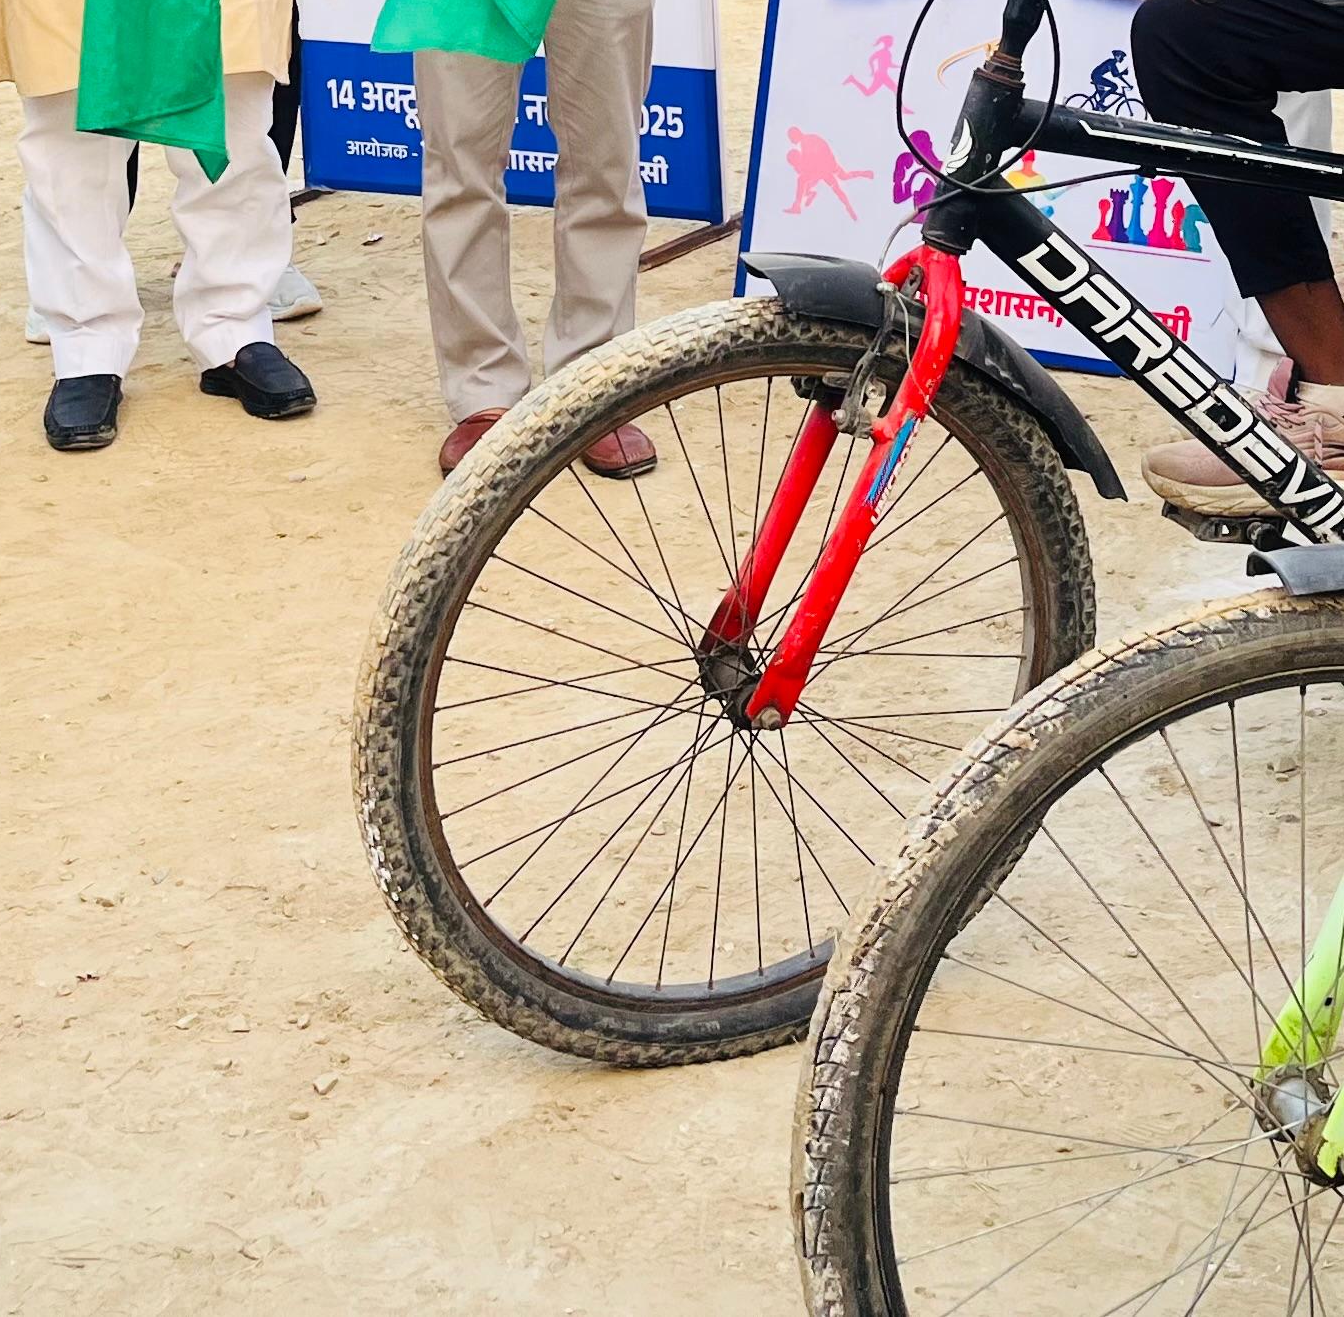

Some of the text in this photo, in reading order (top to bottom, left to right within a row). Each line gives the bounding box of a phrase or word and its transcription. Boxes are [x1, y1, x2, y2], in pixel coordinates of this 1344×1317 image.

[326, 79, 421, 129] 14 अक्टू
[639, 104, 684, 139] 025
